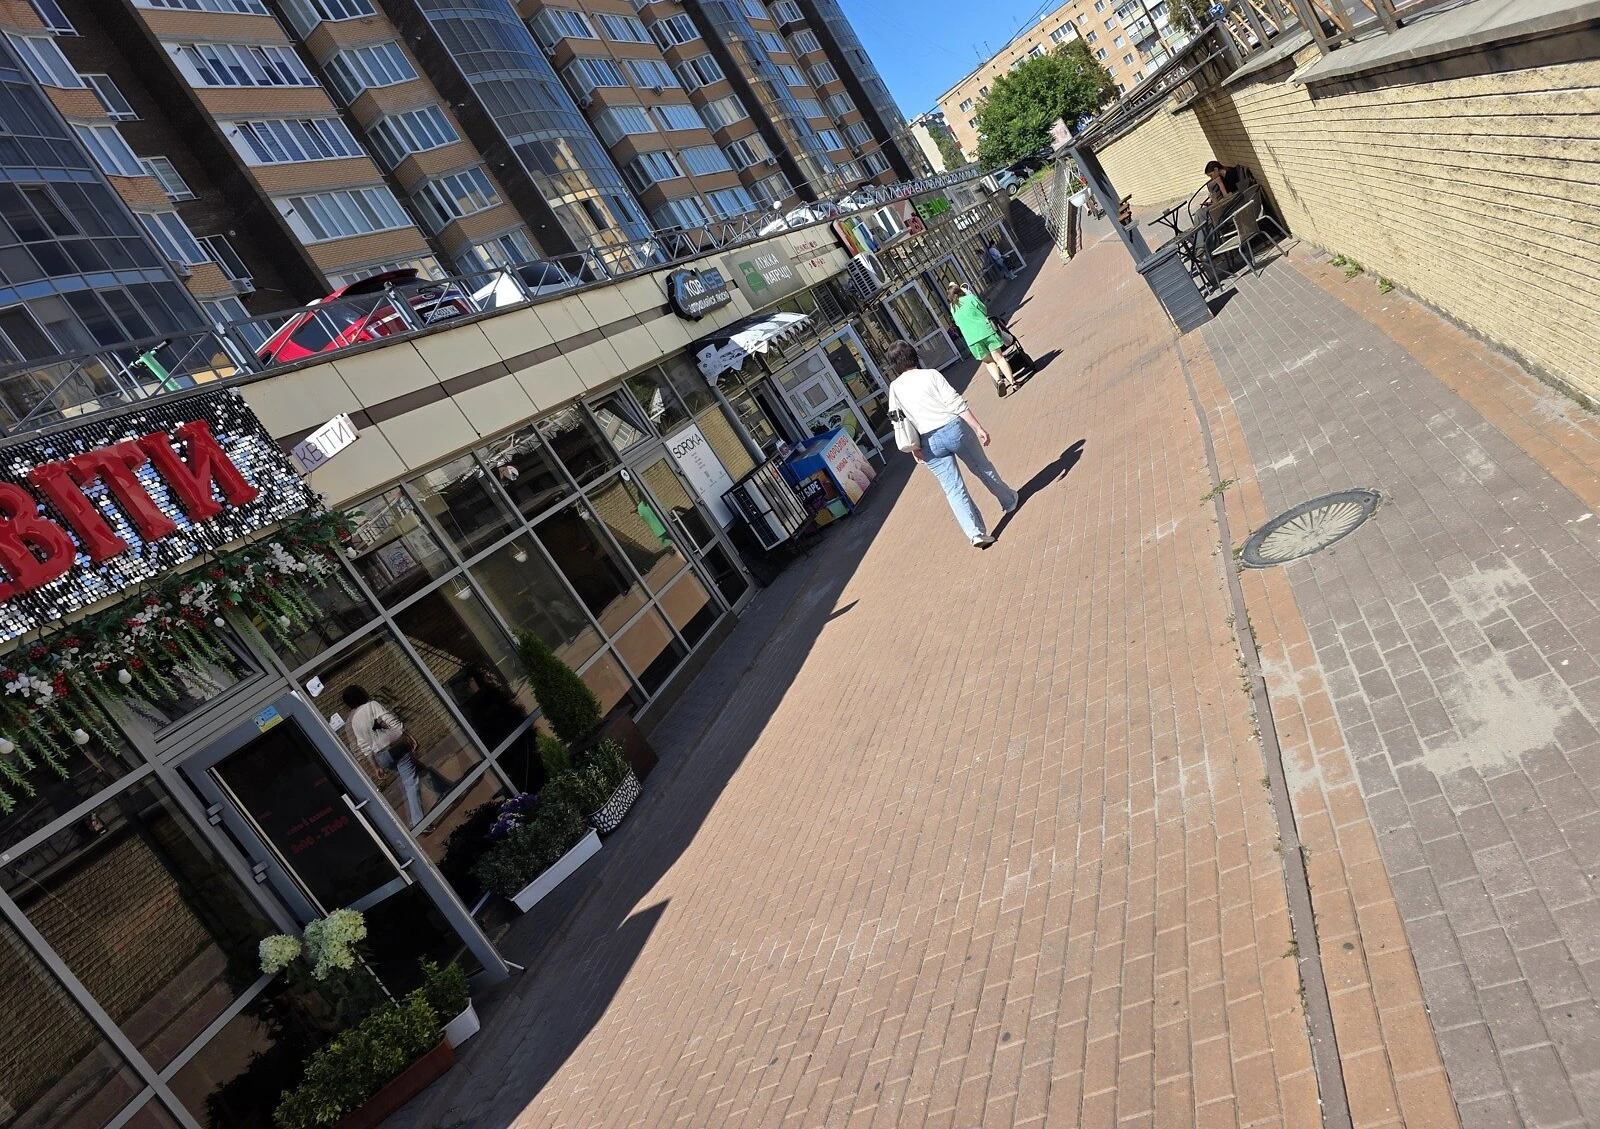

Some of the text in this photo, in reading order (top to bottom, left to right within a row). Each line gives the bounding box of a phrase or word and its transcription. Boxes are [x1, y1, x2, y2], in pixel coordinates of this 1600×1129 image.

[754, 253, 780, 271] ЛІЖКА
[295, 421, 351, 470] КВІТИ
[672, 433, 704, 459] SOROKA
[0, 418, 259, 599] ВІТИ
